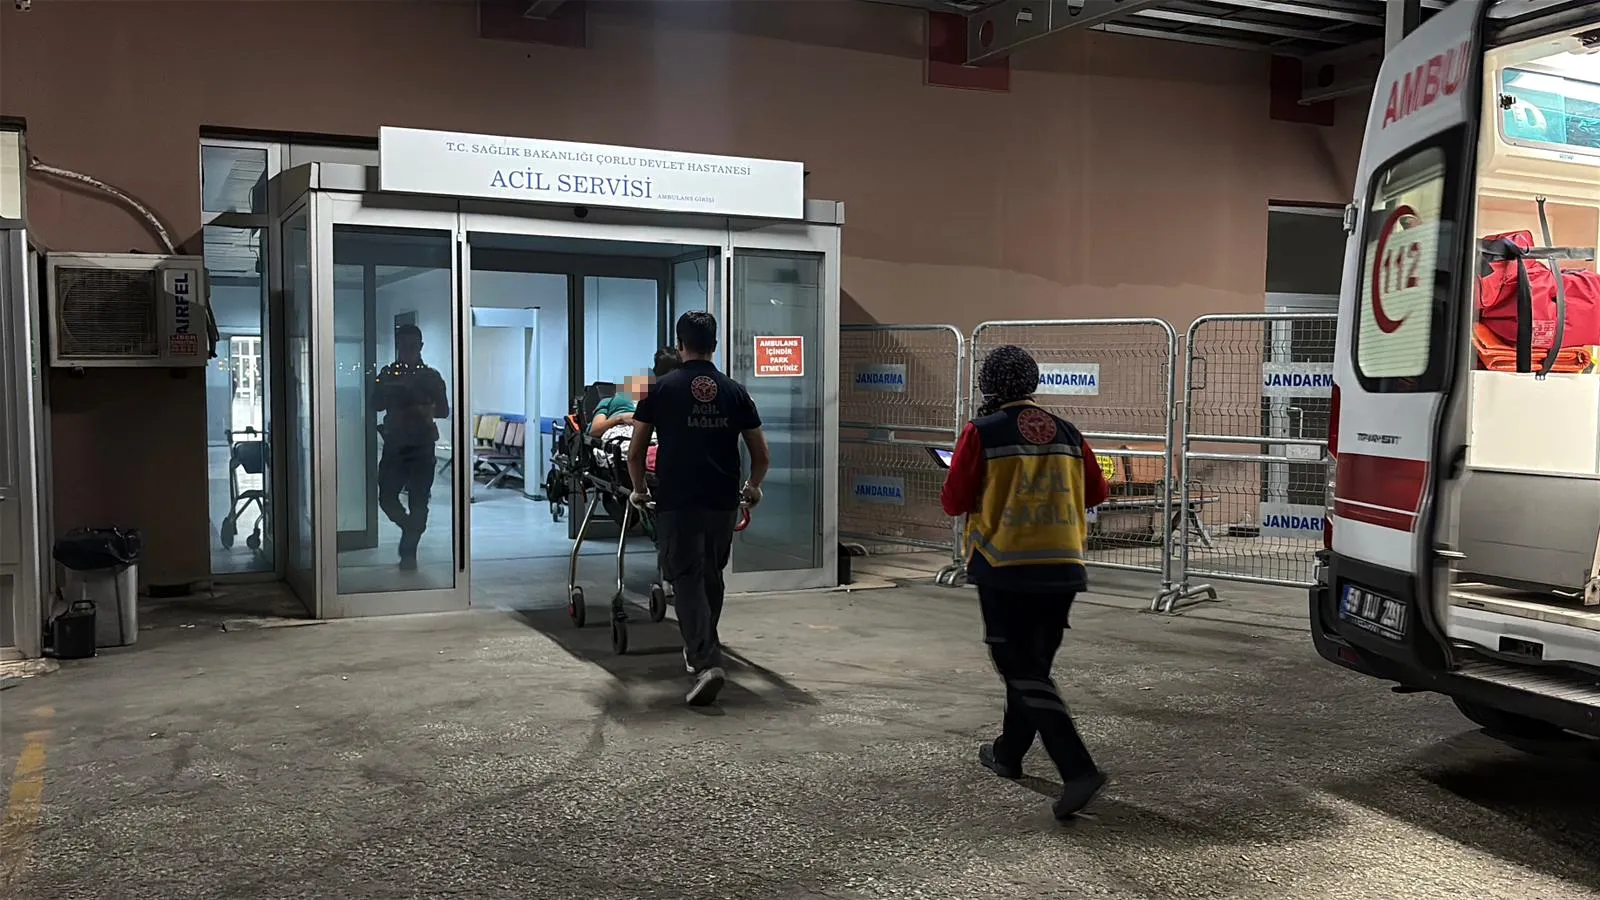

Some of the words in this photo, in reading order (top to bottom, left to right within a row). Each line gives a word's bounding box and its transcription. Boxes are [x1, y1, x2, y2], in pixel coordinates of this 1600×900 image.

[446, 142, 469, 153] T.C.
[472, 143, 520, 157] SAĞLIK
[523, 148, 593, 163] BAKANLIĞI
[596, 154, 637, 166] ÇORLU
[639, 158, 685, 170] DEVLET
[687, 162, 751, 176] HASTANESİ
[490, 166, 551, 191] ACİL
[557, 173, 653, 199] SERVİSİ
[1384, 242, 1420, 294] 112
[174, 272, 189, 334] AIRFEL
[765, 347, 793, 356] İÇİNDİR
[769, 356, 789, 364] PARK
[760, 364, 799, 372] ETMEYİNİZ
[855, 372, 903, 385] JANDARMA
[1038, 373, 1096, 387] ANDARMA
[1264, 373, 1334, 387] JANDARM
[855, 485, 902, 499] JANDARMA
[1003, 502, 1077, 527] SAĞLI
[1262, 514, 1325, 531] JANDAR
